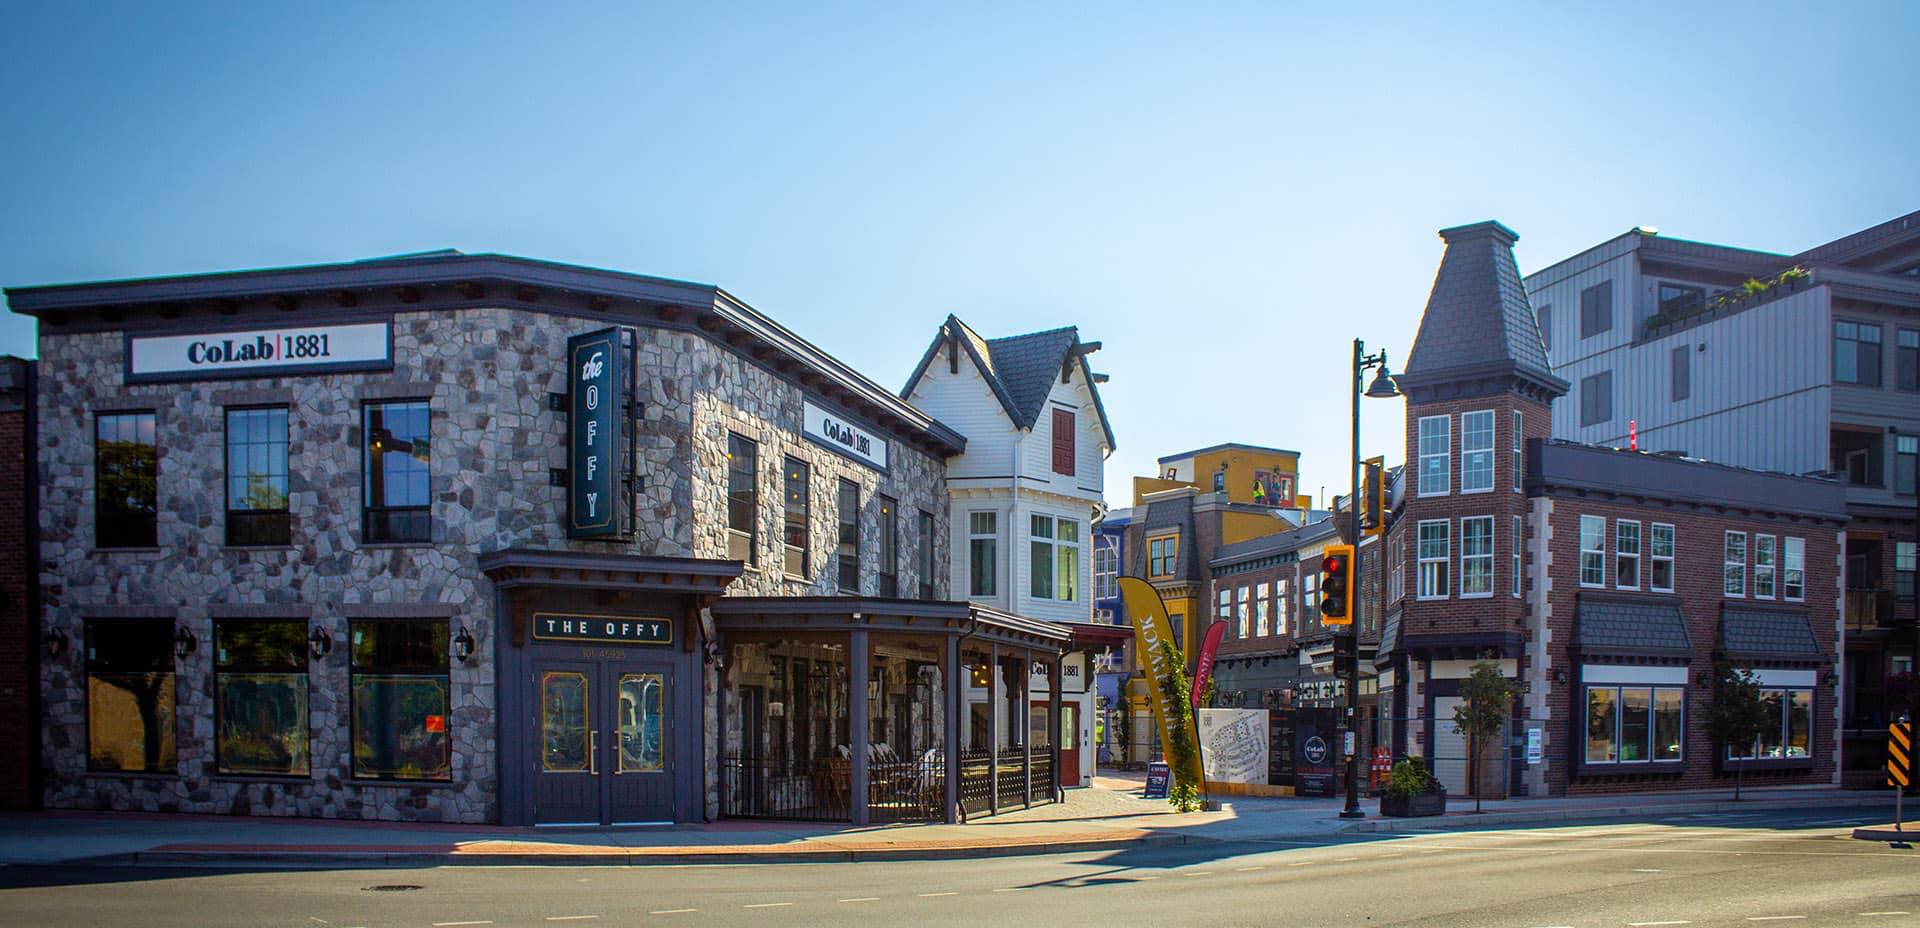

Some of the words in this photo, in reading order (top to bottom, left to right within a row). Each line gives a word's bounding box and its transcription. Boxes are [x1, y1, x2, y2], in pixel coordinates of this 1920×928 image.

[187, 336, 274, 364] CoLab
[284, 334, 331, 359] 1881
[582, 352, 603, 381] the
[586, 384, 599, 518] OFFY
[823, 418, 853, 447] CoLab
[856, 434, 870, 456] 1881
[547, 620, 588, 634] THE
[606, 622, 660, 637] OFFY
[1063, 665, 1079, 677] 1881
